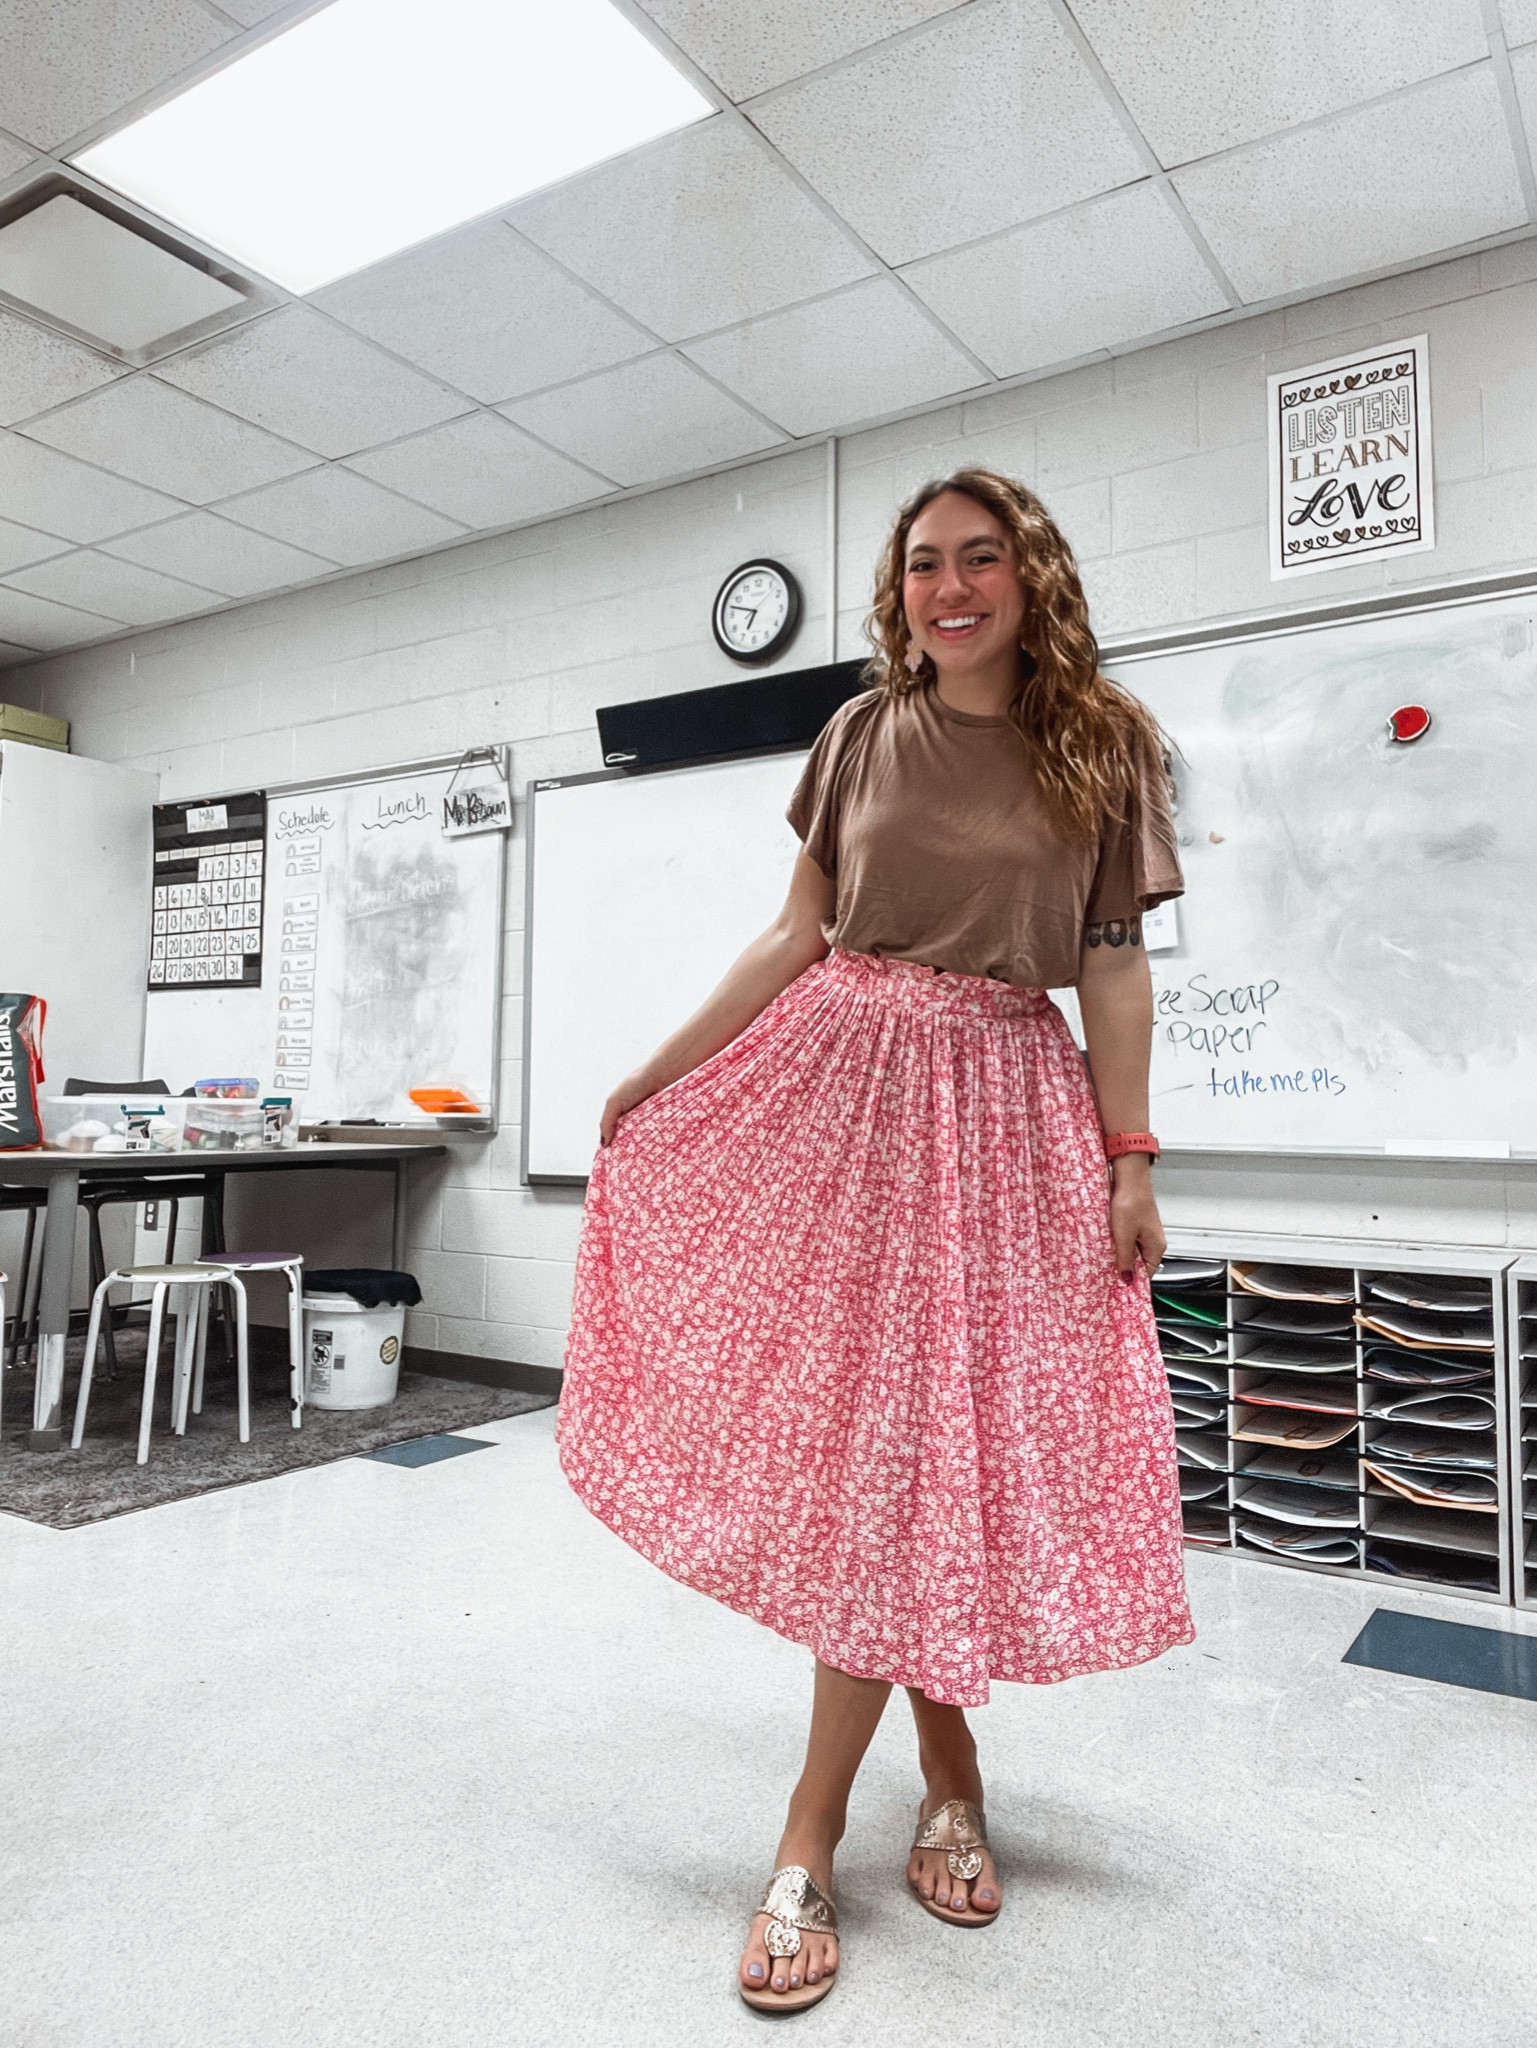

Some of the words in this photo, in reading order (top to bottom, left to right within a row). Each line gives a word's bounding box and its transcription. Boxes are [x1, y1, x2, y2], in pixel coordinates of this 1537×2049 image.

[1289, 385, 1409, 452] LISTEN
[1290, 431, 1410, 482] LEARN
[755, 578, 762, 586] 12
[776, 590, 781, 598] 2
[752, 636, 756, 644] 6
[764, 631, 769, 639] 5
[378, 793, 426, 818] Lunch
[279, 806, 331, 831] Schedule
[204, 863, 208, 878] 1
[218, 861, 225, 876] 2
[235, 860, 240, 874] 3
[251, 858, 257, 871] 4
[158, 891, 163, 905] 5
[172, 890, 177, 903] 6
[186, 889, 191, 902] 7
[201, 887, 206, 901] 8
[217, 886, 223, 899] 9
[232, 883, 240, 898] 10
[251, 883, 256, 896] 11
[156, 915, 163, 930] 12
[170, 915, 177, 928] 13
[185, 914, 192, 927] 14
[199, 912, 206, 926] 15
[214, 911, 223, 924] 16
[232, 910, 239, 923] 17
[248, 908, 256, 922] 18
[156, 941, 163, 955] 19
[169, 940, 178, 954] 20
[185, 940, 192, 953] 21
[197, 938, 208, 952] 22
[212, 937, 223, 951] 23
[229, 936, 240, 949] 24
[246, 934, 257, 948] 25
[152, 966, 163, 979] 26
[168, 966, 177, 978] 27
[182, 964, 192, 977] 28
[197, 963, 207, 976] 29
[211, 962, 222, 975] 30
[230, 961, 238, 975] 31
[1188, 974, 1279, 1016] Scrap
